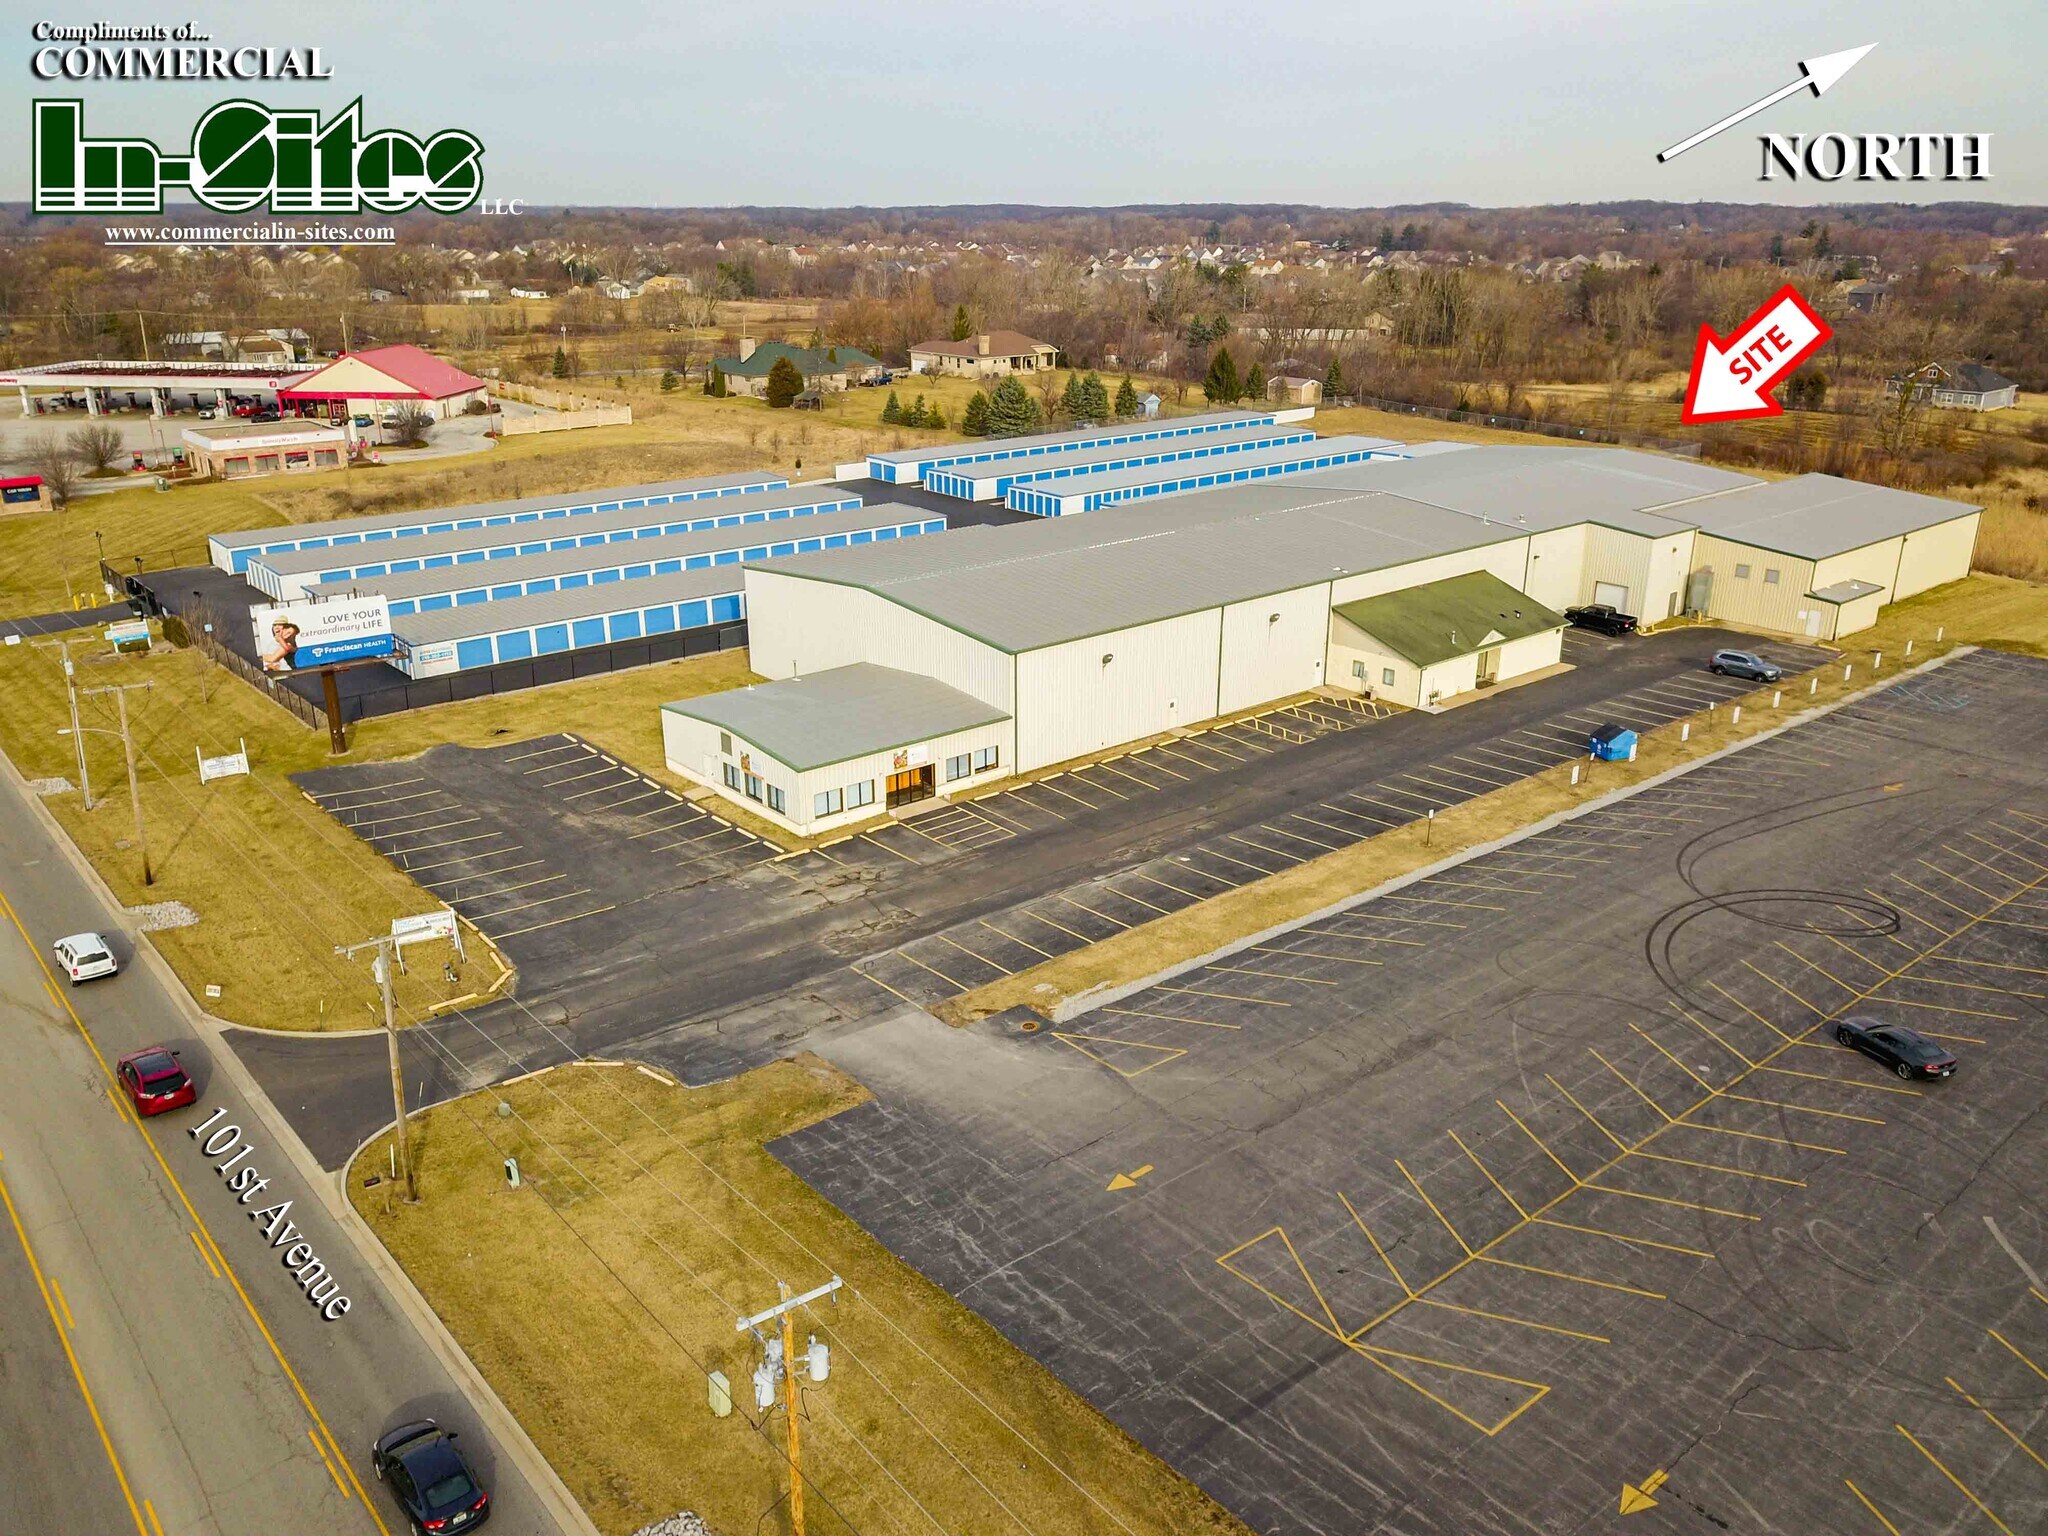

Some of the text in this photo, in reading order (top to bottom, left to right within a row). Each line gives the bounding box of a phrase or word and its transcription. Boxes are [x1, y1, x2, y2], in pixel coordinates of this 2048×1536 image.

[322, 608, 382, 625] LOVE YOUR
[300, 619, 383, 638] extraordinary LIFE
[324, 639, 387, 654] Franciscan HEALTH
